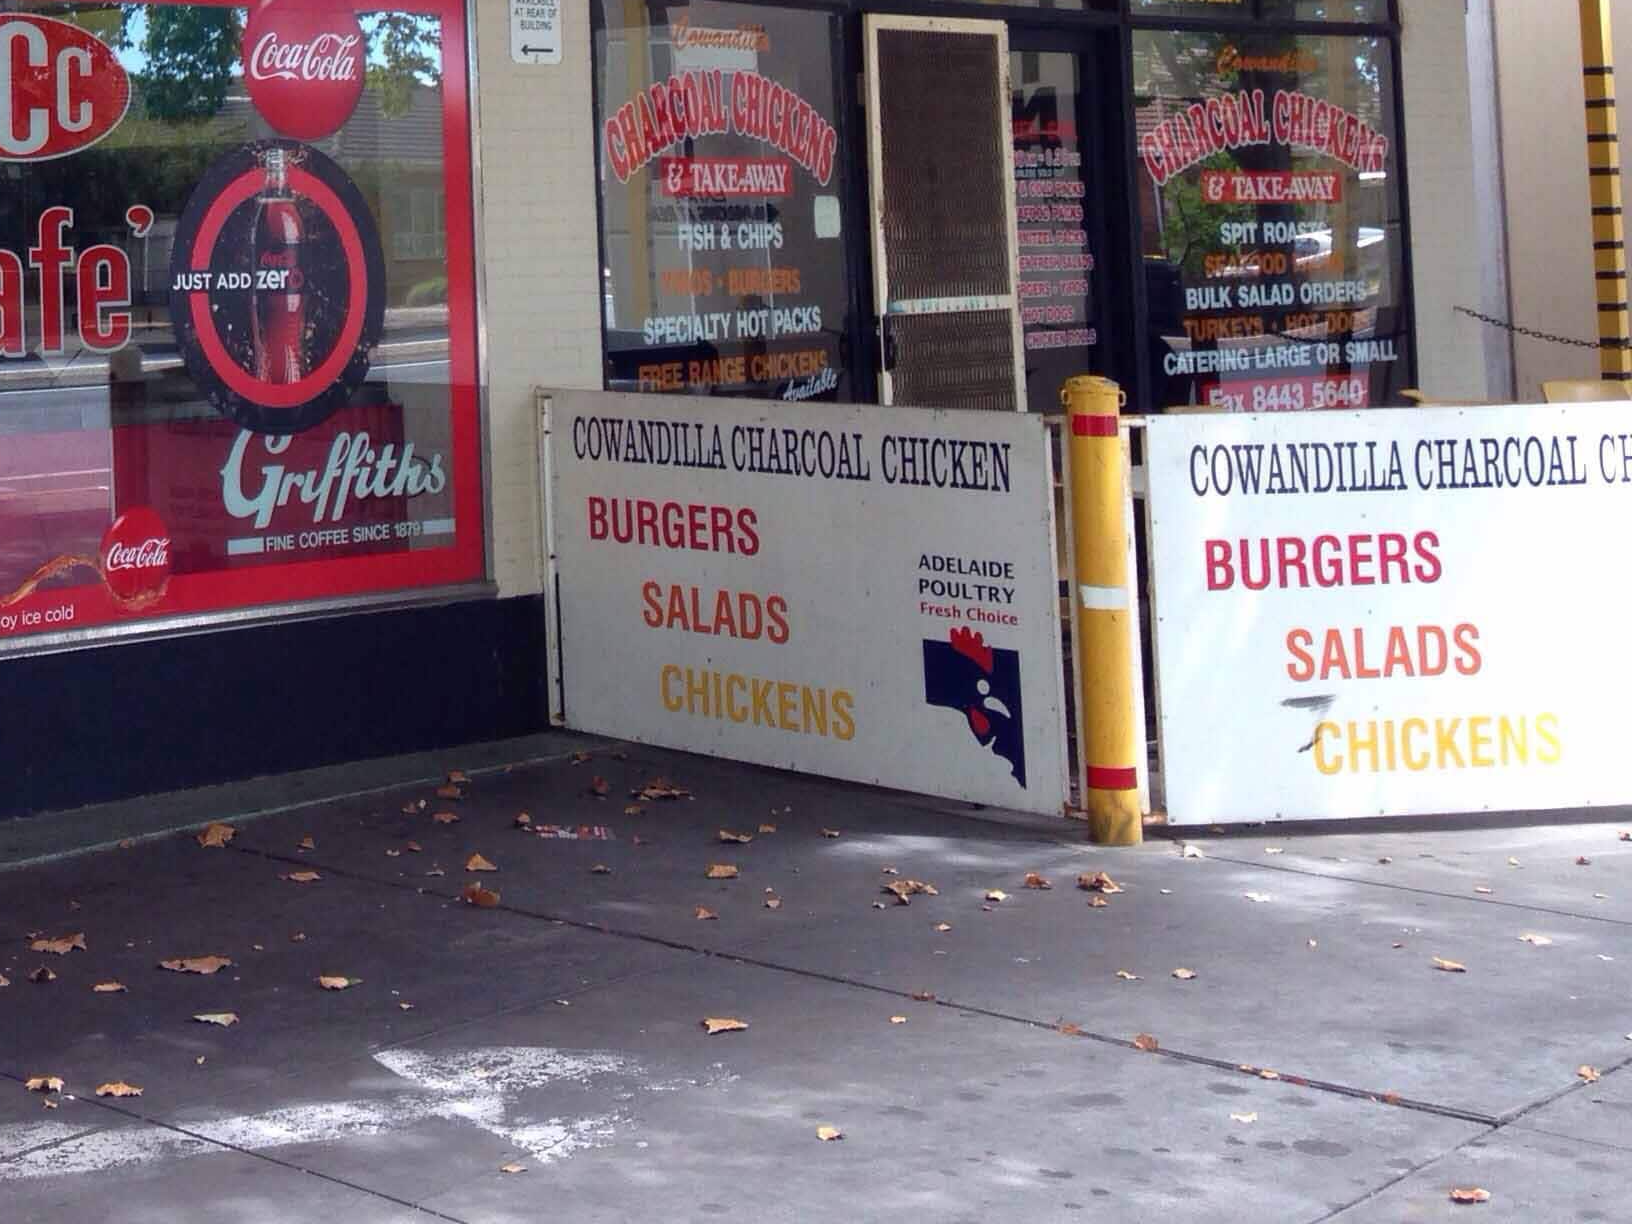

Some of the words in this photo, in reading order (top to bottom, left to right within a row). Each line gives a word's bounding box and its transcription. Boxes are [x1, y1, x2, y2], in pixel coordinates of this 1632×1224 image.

[604, 69, 729, 184] CHARCOAL
[730, 70, 838, 187] CHICKENS
[1141, 88, 1271, 187] CHARCOAL
[1271, 88, 1389, 178] CHICKENS
[678, 223, 716, 251] FISH
[720, 223, 732, 251] &
[737, 222, 784, 250] CHIPS
[1220, 222, 1259, 245] SPIT
[172, 273, 212, 291] JUST
[216, 272, 252, 290] ADD
[1186, 284, 1233, 310] BULK
[1238, 282, 1295, 308] SALAD
[1300, 279, 1368, 304] ORDERS
[643, 312, 732, 345] SPECIALTY
[736, 309, 768, 338] HOT
[773, 304, 822, 335] PACKS
[1183, 314, 1265, 342] TURKEYS
[638, 363, 684, 392] FREE
[688, 355, 745, 387] RANGE
[751, 350, 830, 381] CHICKENS
[1163, 349, 1250, 376] CATERING
[1254, 343, 1312, 369] LARGE
[1316, 342, 1341, 364] OR
[1344, 339, 1398, 362] SMALL
[782, 367, 838, 402] Available
[1252, 383, 1304, 413] 8443
[1311, 379, 1366, 406] 5640
[573, 415, 727, 472] COWANDILLA
[731, 423, 871, 482] CHARCOAL
[880, 433, 1012, 494] CHICKEN
[1189, 440, 1409, 498] COWANDILLA
[1414, 435, 1588, 491] CHARCOAL
[220, 429, 446, 529] Griffiths
[265, 533, 295, 553] FINE
[298, 529, 350, 549] COFFEE
[352, 524, 391, 542] SINCE
[393, 520, 423, 539] 1879
[588, 495, 760, 557] BURGERS
[918, 553, 1016, 580] ADELAIDE
[1205, 530, 1443, 592] BURGERS
[918, 577, 1016, 605] POULTRY
[21, 610, 42, 626] ice
[44, 604, 75, 623] cold
[642, 579, 791, 645] SALADS
[920, 600, 962, 621] Fresh
[966, 606, 1019, 627] Choice
[1285, 622, 1483, 683] SALADS
[660, 663, 856, 742] CHICKENS
[1312, 711, 1564, 777] CHICKENS
